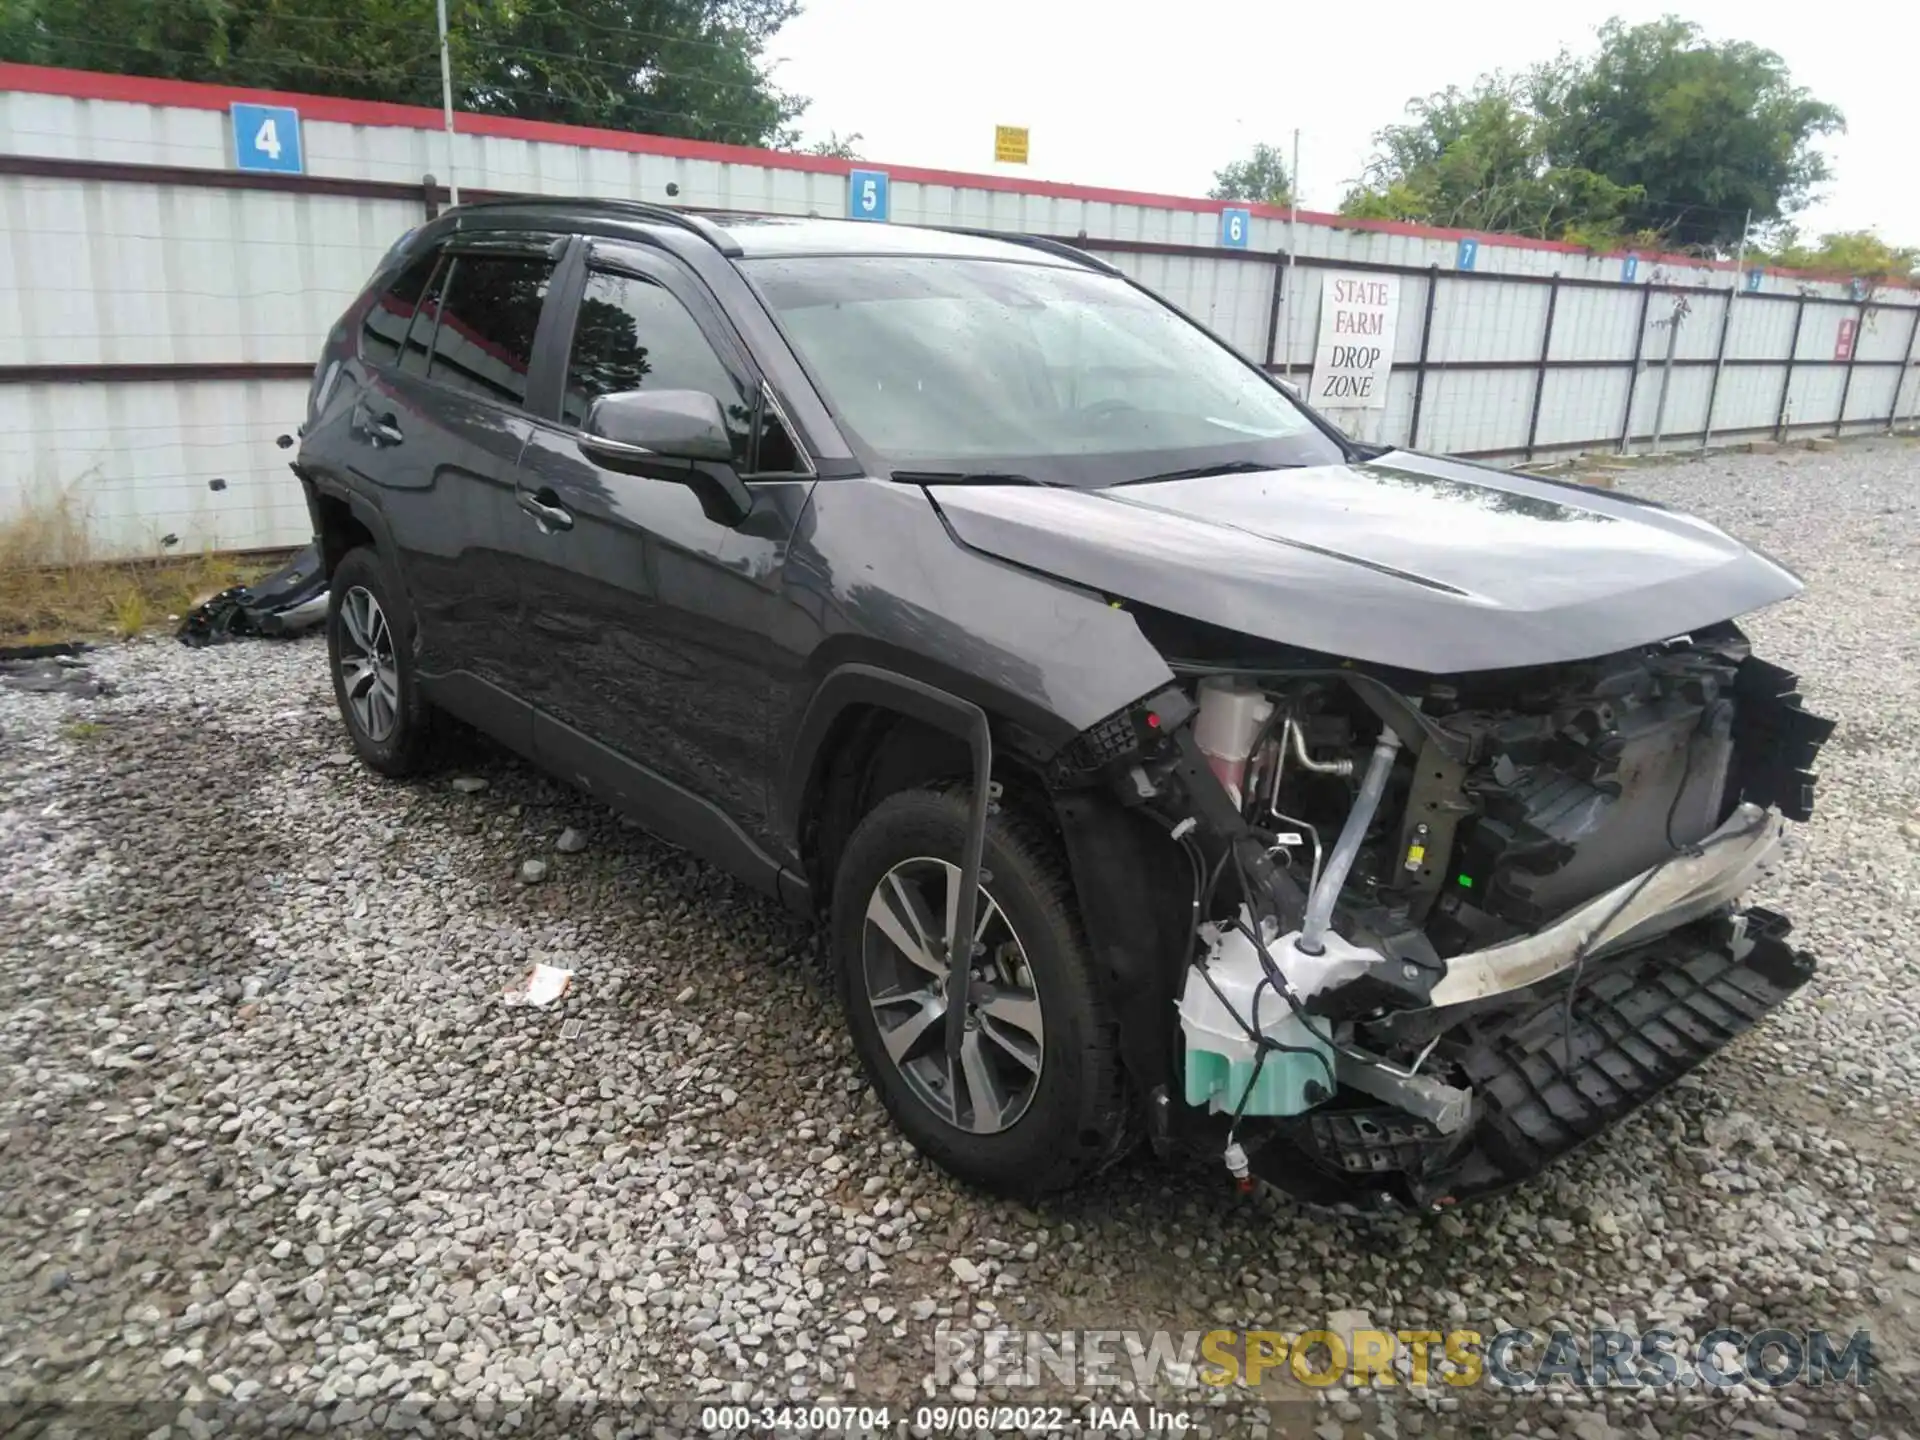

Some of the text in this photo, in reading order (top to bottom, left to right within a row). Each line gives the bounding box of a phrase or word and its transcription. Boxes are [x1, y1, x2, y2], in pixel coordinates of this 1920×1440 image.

[254, 119, 281, 160] 4
[862, 179, 877, 212] 5
[1231, 216, 1241, 241] 6
[1464, 243, 1473, 264] 7
[1334, 279, 1388, 306] STATE
[1335, 310, 1384, 335] FARM
[1331, 345, 1381, 369] DROP
[1323, 375, 1374, 398] ZONE
